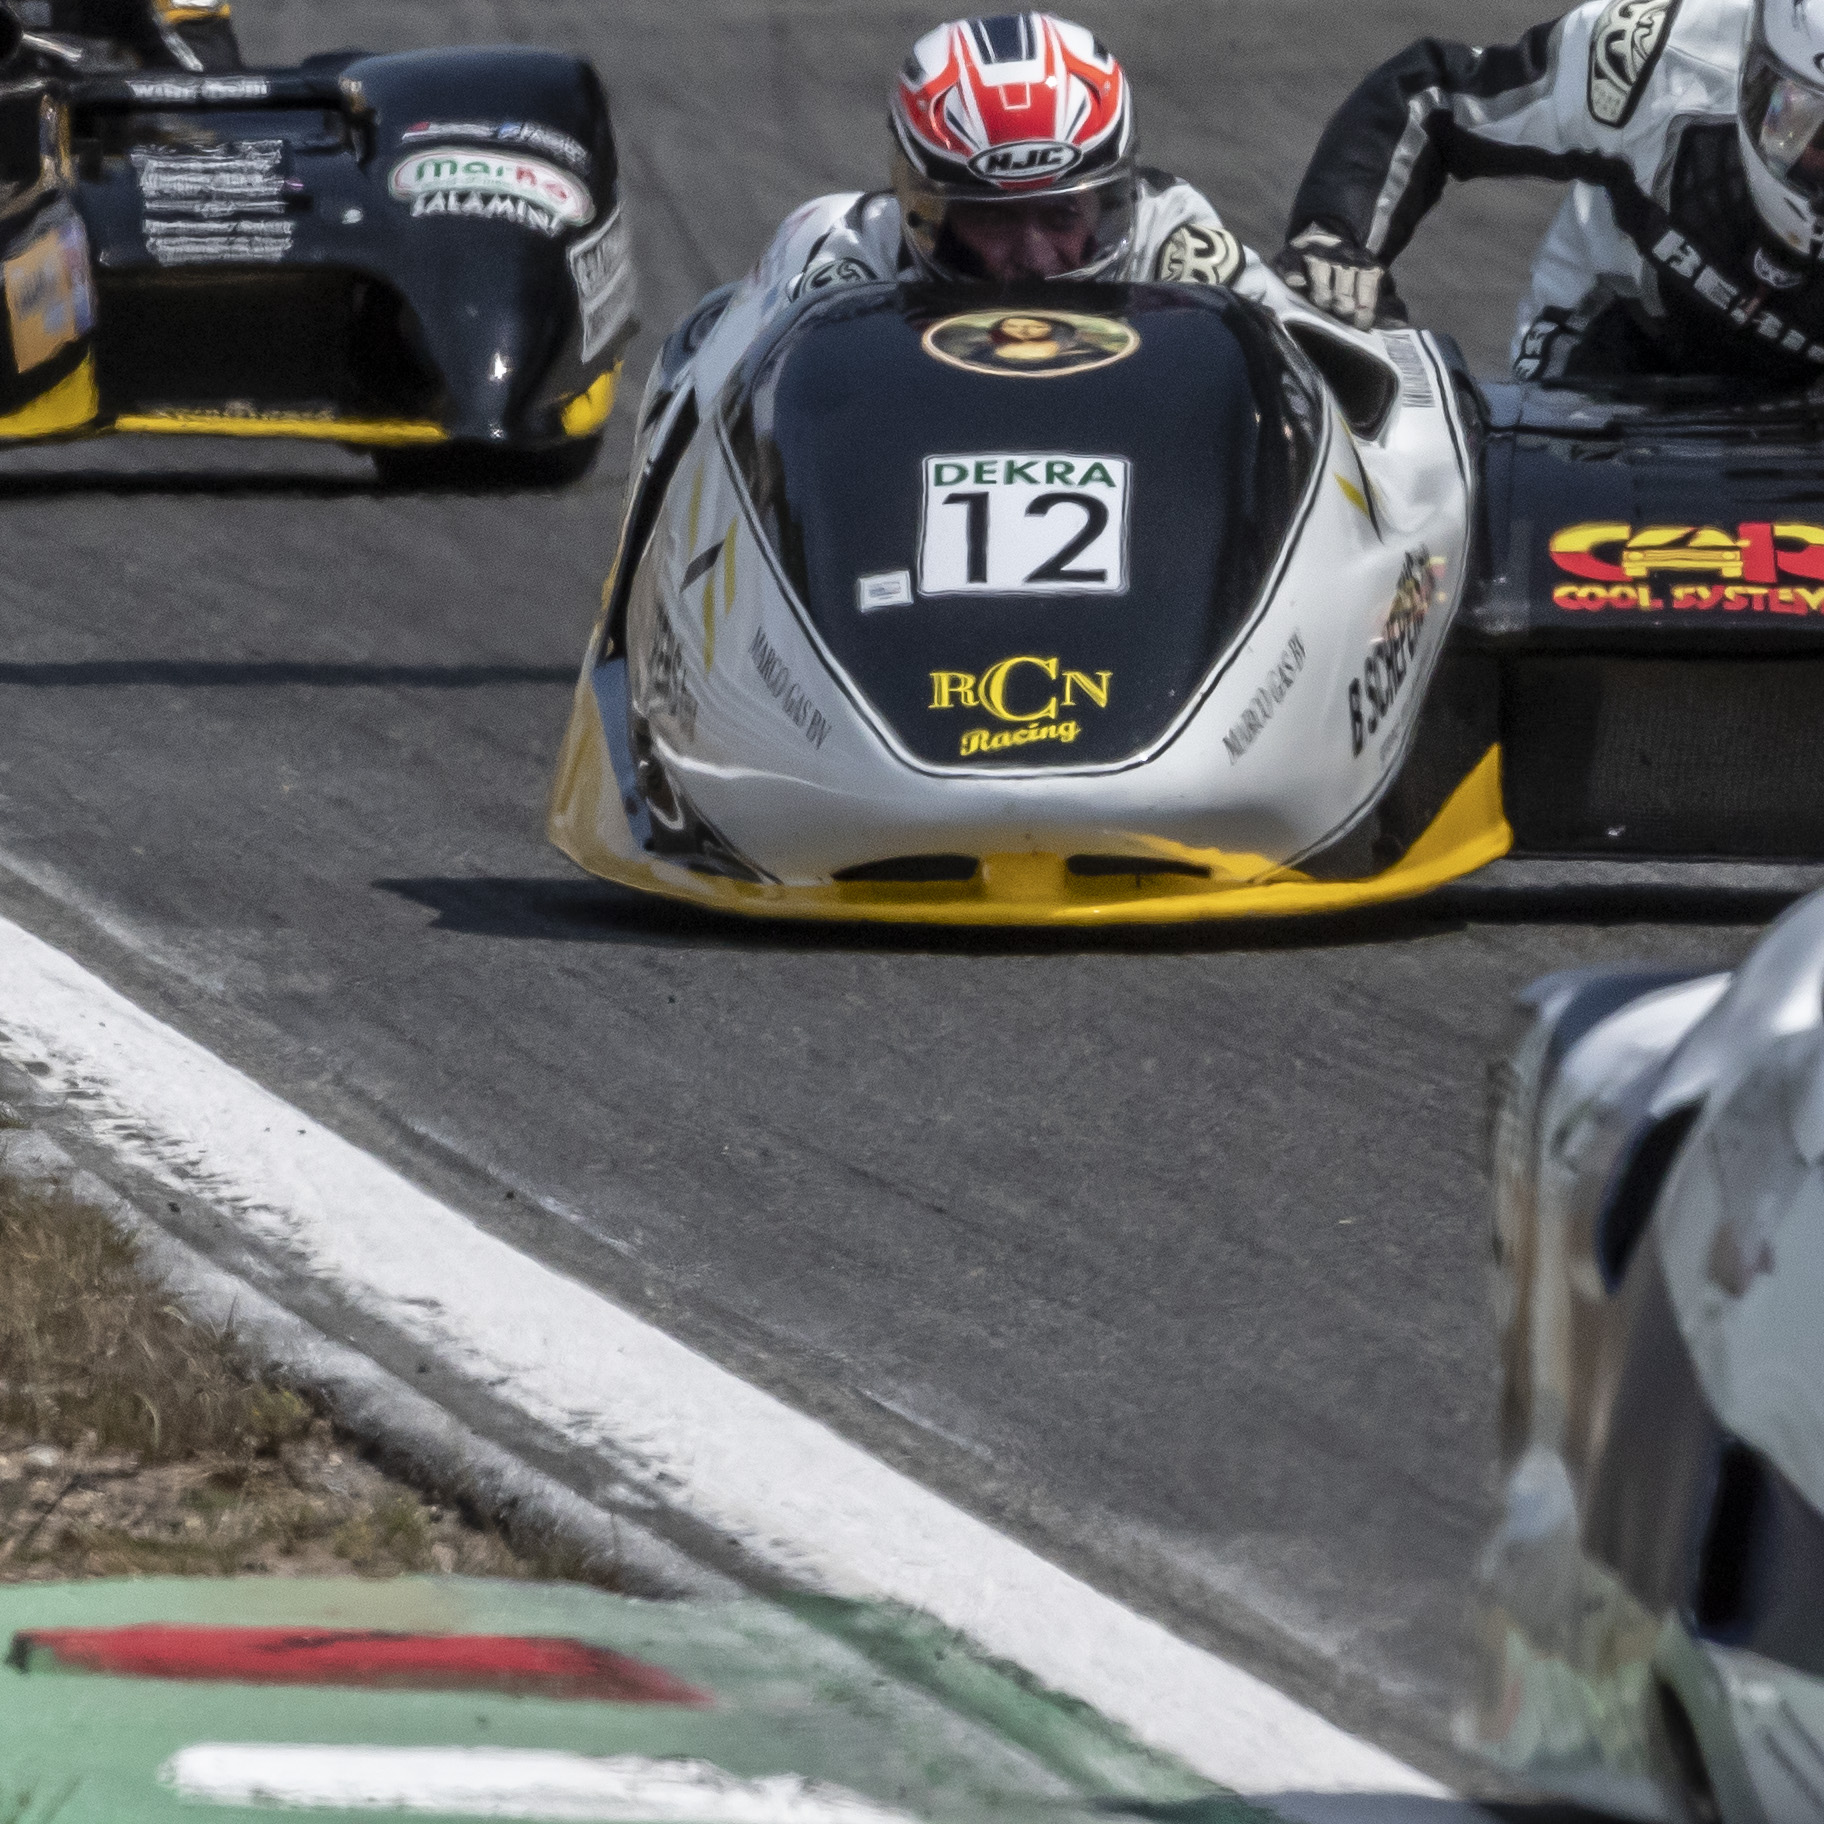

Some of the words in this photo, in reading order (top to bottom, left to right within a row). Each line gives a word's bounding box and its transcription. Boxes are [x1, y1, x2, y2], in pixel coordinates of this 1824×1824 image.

[985, 146, 1065, 173] HJC
[410, 190, 566, 238] SALAMINI
[934, 460, 1117, 488] DEKRA
[942, 491, 1110, 584] 12
[1553, 583, 1664, 612] COOL
[929, 656, 1113, 722] RCN
[960, 720, 1082, 756] Racing
